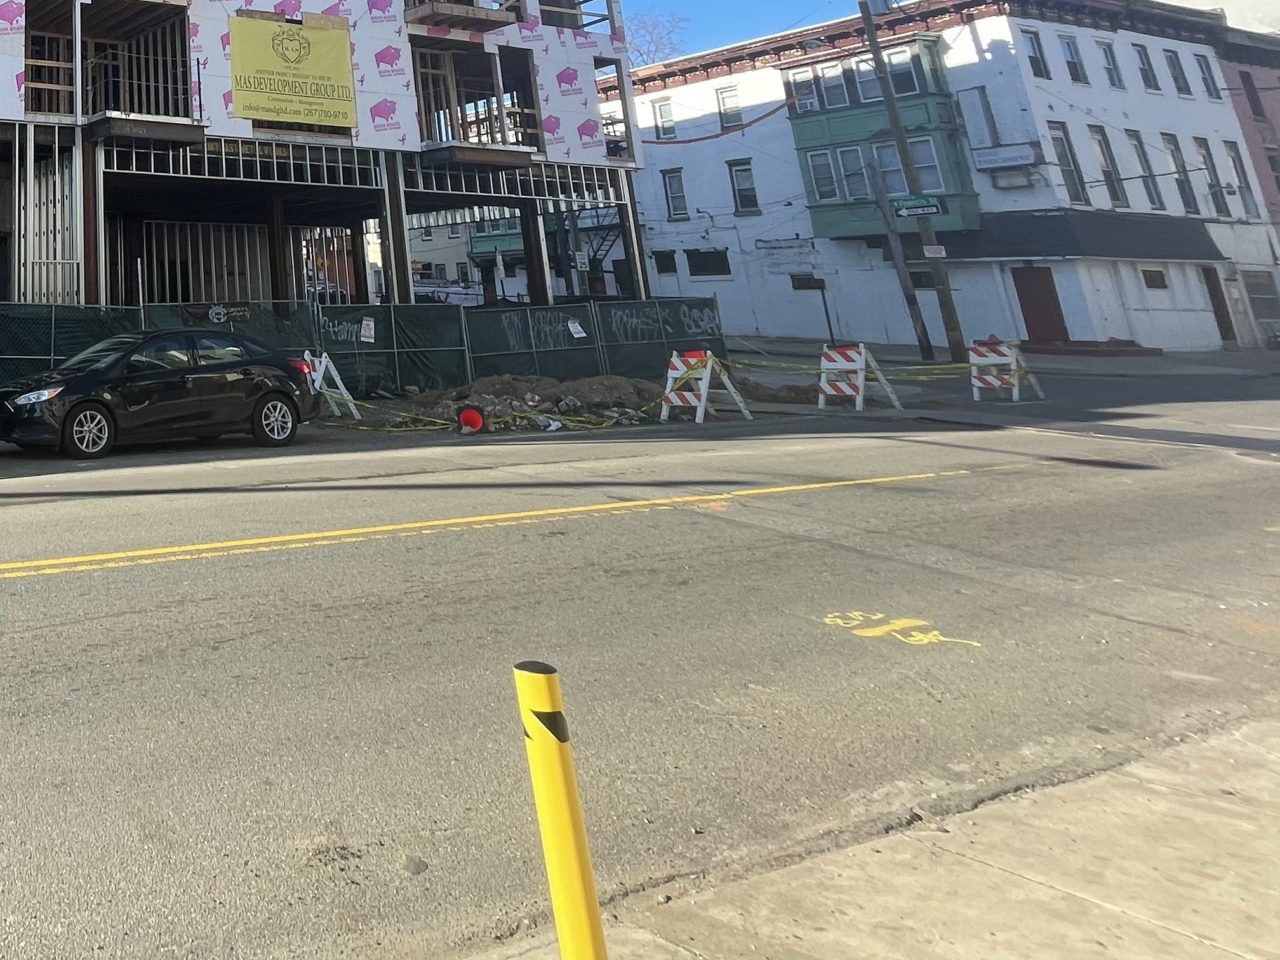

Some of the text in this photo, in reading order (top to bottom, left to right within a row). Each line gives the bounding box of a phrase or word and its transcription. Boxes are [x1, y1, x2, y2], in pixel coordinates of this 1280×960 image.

[234, 74, 353, 100] MAS DEVELOPMENT GROUP LTD.
